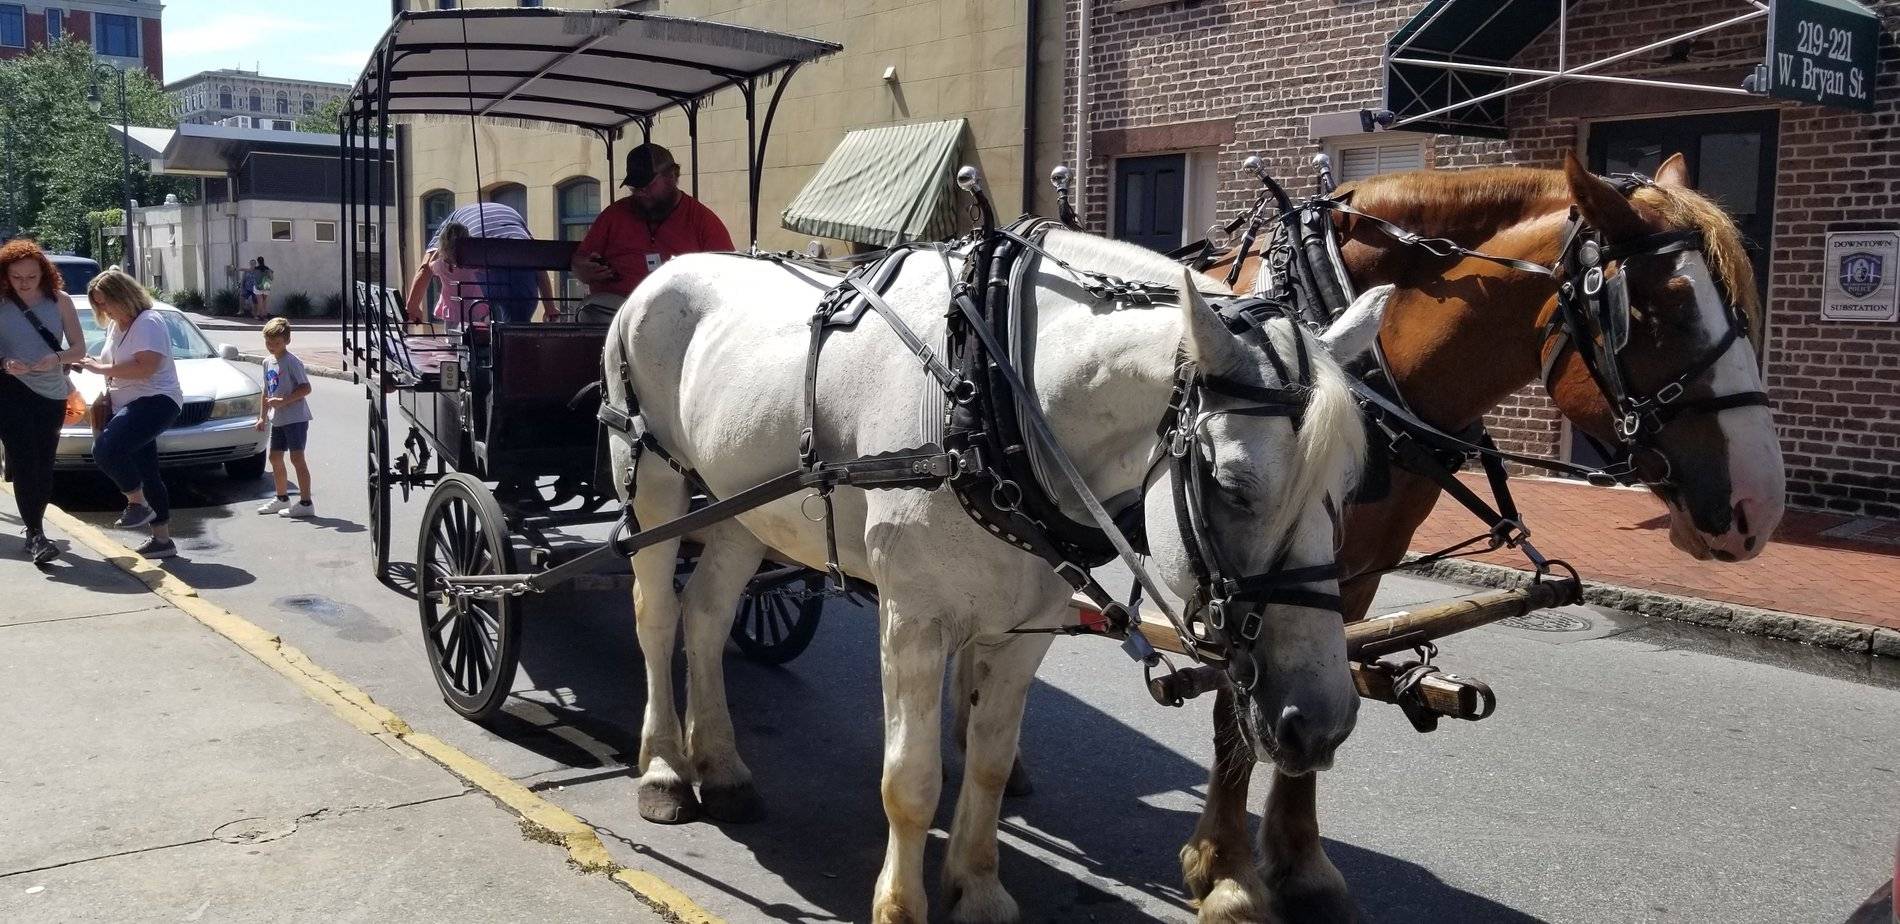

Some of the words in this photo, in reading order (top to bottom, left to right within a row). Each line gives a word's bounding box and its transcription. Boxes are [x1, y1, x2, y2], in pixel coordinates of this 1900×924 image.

[1797, 20, 1852, 62] 219-221
[1778, 52, 1796, 88] W.
[1801, 57, 1844, 101] Bryan
[1848, 67, 1866, 100] St.
[1834, 240, 1892, 248] DOWNTOWN
